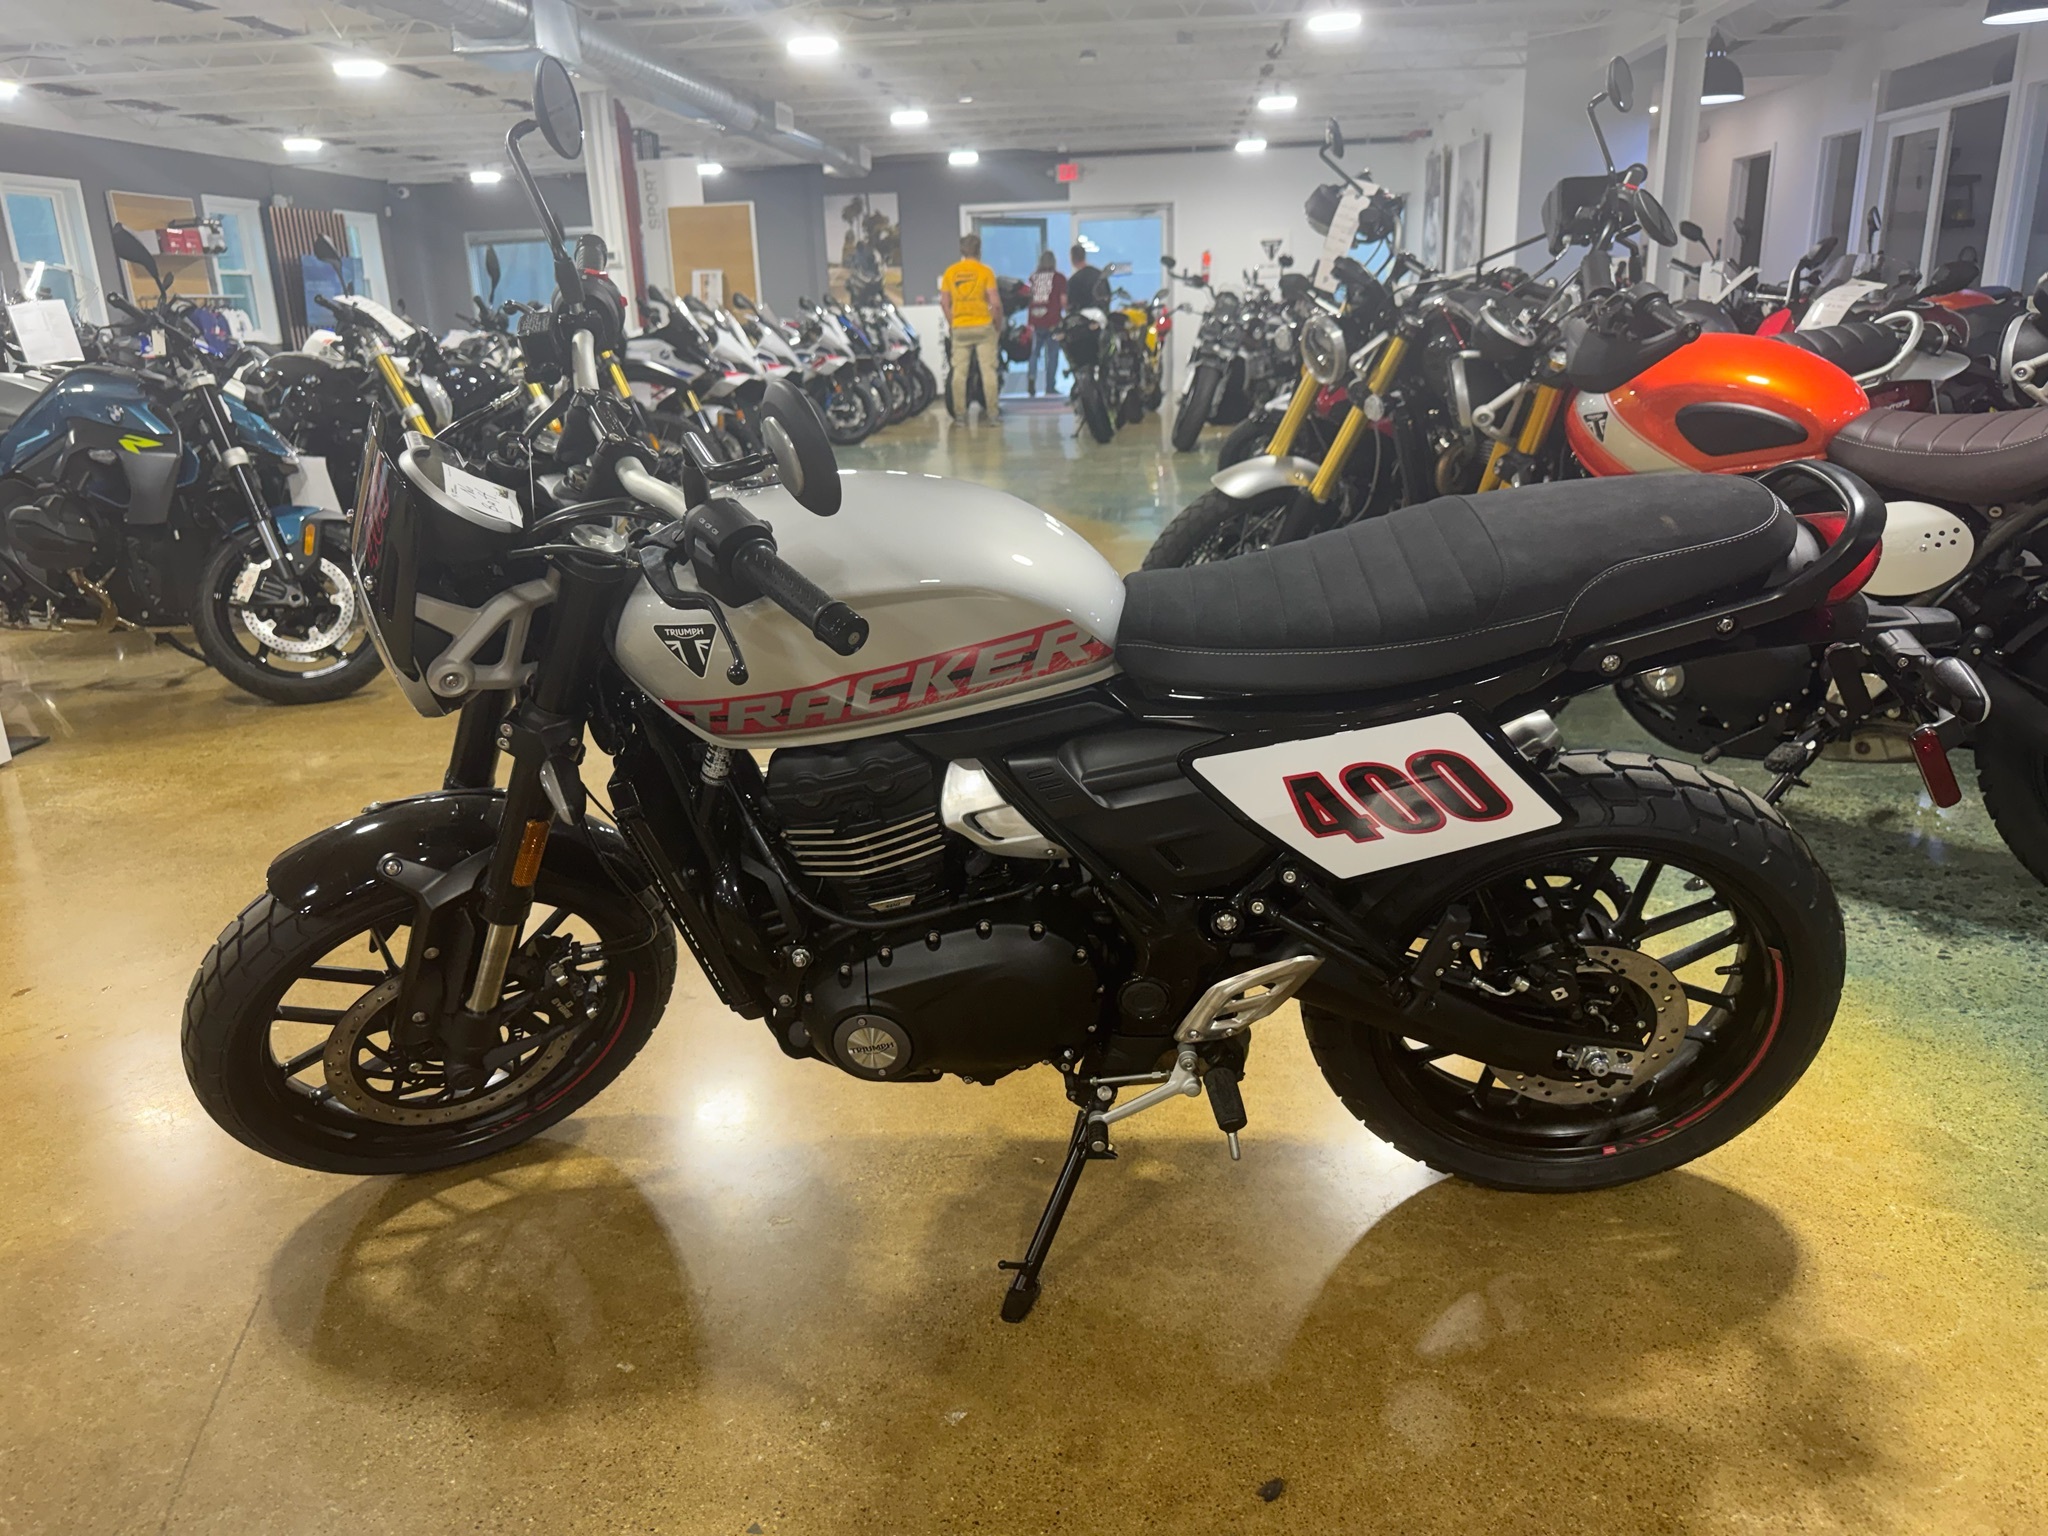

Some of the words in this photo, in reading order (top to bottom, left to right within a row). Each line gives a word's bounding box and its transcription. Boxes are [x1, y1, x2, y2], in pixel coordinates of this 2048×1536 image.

[643, 168, 661, 230] SPORT
[664, 627, 705, 639] TRIUMPH
[678, 626, 1096, 734] TRACKER
[1282, 748, 1514, 844] 400
[850, 1041, 895, 1055] TRIUMPH
